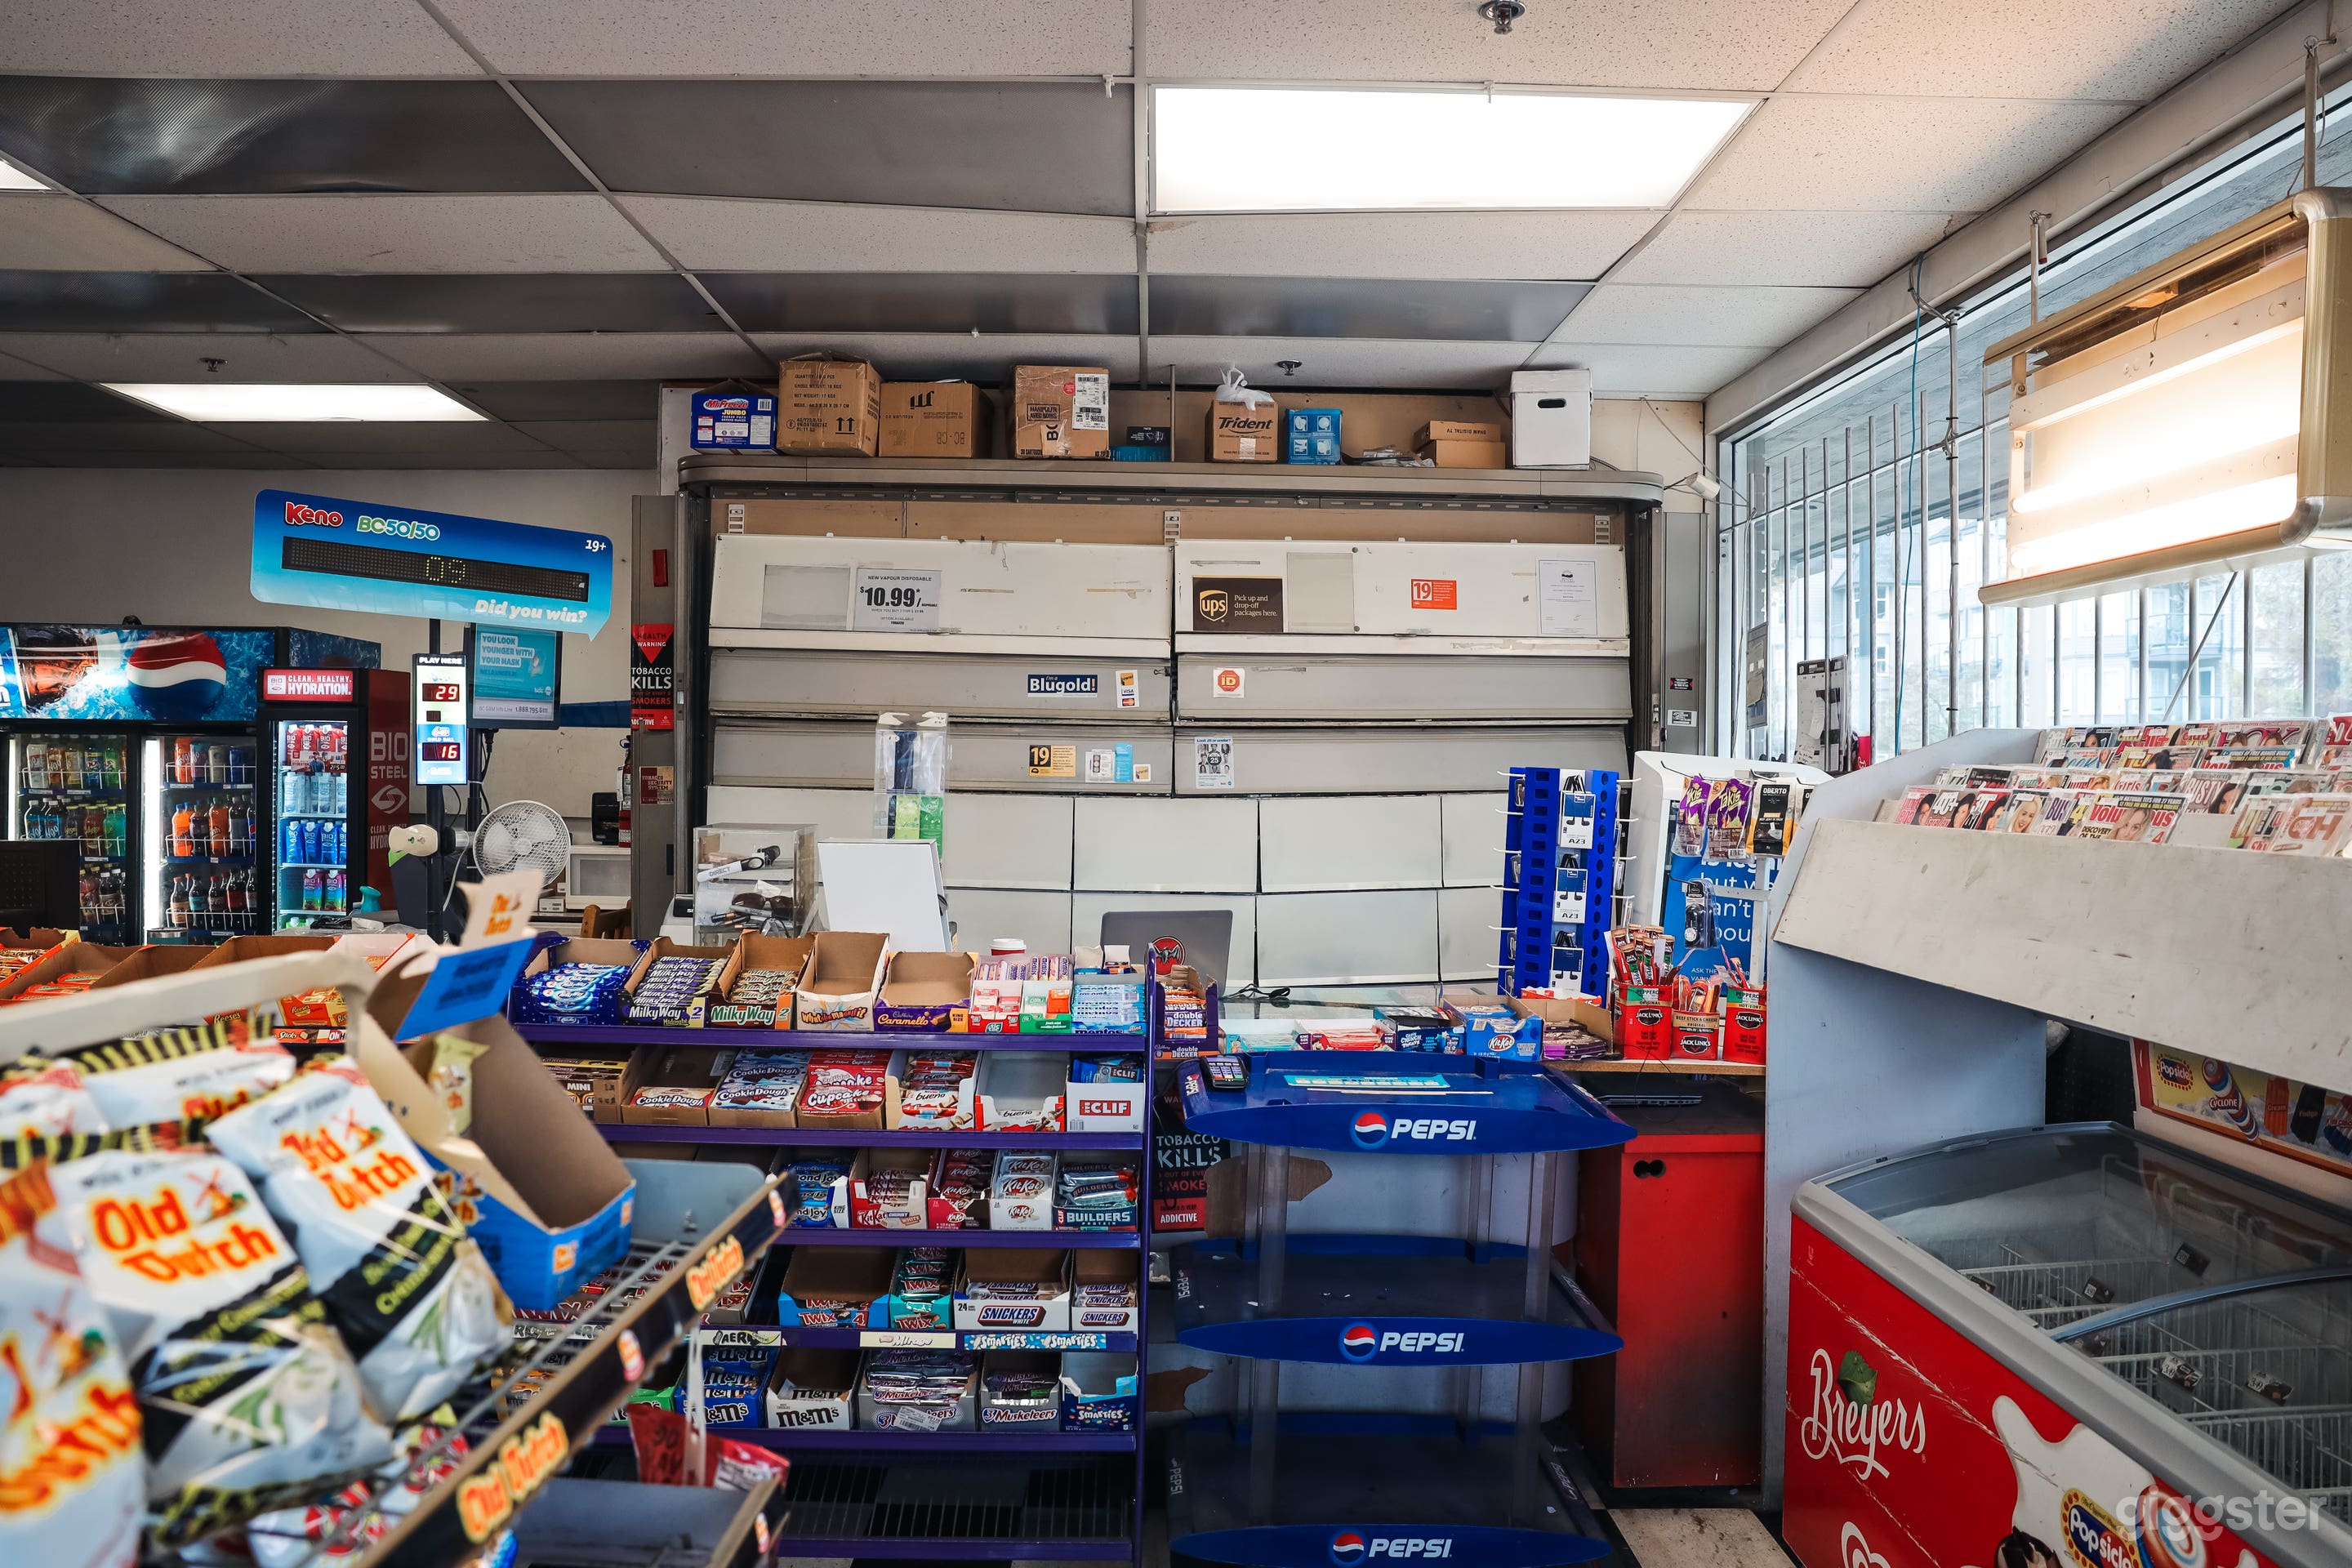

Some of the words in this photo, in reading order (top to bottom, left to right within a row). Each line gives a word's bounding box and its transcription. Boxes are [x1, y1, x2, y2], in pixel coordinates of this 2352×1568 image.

[1218, 416, 1273, 430] Trident
[284, 501, 343, 528] Keno
[585, 539, 607, 552] 19+
[1414, 582, 1431, 599] 19
[474, 599, 506, 617] Did
[509, 605, 543, 621] you
[546, 608, 588, 623] win?
[1202, 599, 1226, 617] ups
[482, 646, 514, 654] YOUNGER
[515, 648, 533, 657] WITH
[419, 657, 441, 665] PLAY
[482, 656, 500, 664] YOUR
[501, 657, 520, 666] MASK
[631, 667, 672, 675] TOBACCO
[631, 676, 672, 689] KILLS
[1030, 677, 1096, 693] Blugold!
[1221, 677, 1236, 686] ID
[287, 683, 352, 695] HYDRATION.
[435, 686, 458, 700] 29
[631, 697, 671, 706] SMOKERS
[371, 731, 408, 761] BIO
[442, 745, 457, 759] 16
[1030, 746, 1050, 765] 19
[371, 765, 408, 779] STEEL
[1719, 791, 1741, 811] Takis
[2082, 826, 2112, 835] DISCOVERY
[692, 1006, 704, 1017] 2
[777, 1007, 789, 1018] 2
[800, 1007, 868, 1024] Whatchamacallit
[1174, 1011, 1202, 1019] double
[877, 1013, 929, 1026] Caramello
[1167, 1018, 1203, 1027] DECKER
[1128, 1025, 1142, 1033] mint
[1171, 1050, 1199, 1058] DECKER
[1116, 1070, 1137, 1079] CLIF
[2160, 1062, 2191, 1080] Popsicle
[567, 1083, 590, 1091] MINI
[808, 1089, 869, 1105] Cupcake
[915, 1092, 946, 1101] bueno
[1091, 1102, 1129, 1114] CLIF
[2209, 1098, 2238, 1109] CYCLONE
[2267, 1103, 2287, 1111] Cream
[1003, 1109, 1033, 1118] bueno
[1391, 1119, 1477, 1140] PEPSI
[1156, 1134, 1221, 1146] TOBACCO
[1157, 1145, 1222, 1169] KILLS
[1003, 1176, 1044, 1193] KitKat
[860, 1210, 887, 1225] KitKat
[1008, 1205, 1035, 1217] KitKat
[1067, 1211, 1131, 1223] BUILDERS
[92, 1185, 192, 1253] Old
[902, 1215, 921, 1223] WHITE
[1160, 1213, 1198, 1223] ADDICTIVE
[120, 1223, 279, 1282] Dutch
[958, 1303, 968, 1312] 24
[982, 1306, 1037, 1321] SNICKERS
[1084, 1312, 1129, 1322] SNICKERS
[893, 1335, 933, 1347] Mirage
[982, 1334, 1027, 1348] SMARTIES
[1050, 1334, 1098, 1348] SMARTIES
[1379, 1332, 1464, 1352] PEPSI
[777, 1407, 839, 1428] m&m's
[994, 1407, 1057, 1422] Musketeers
[1078, 1409, 1123, 1420] SMARTIES
[1802, 1348, 1927, 1481] Breyers
[1369, 1539, 1452, 1558] PEPSI
